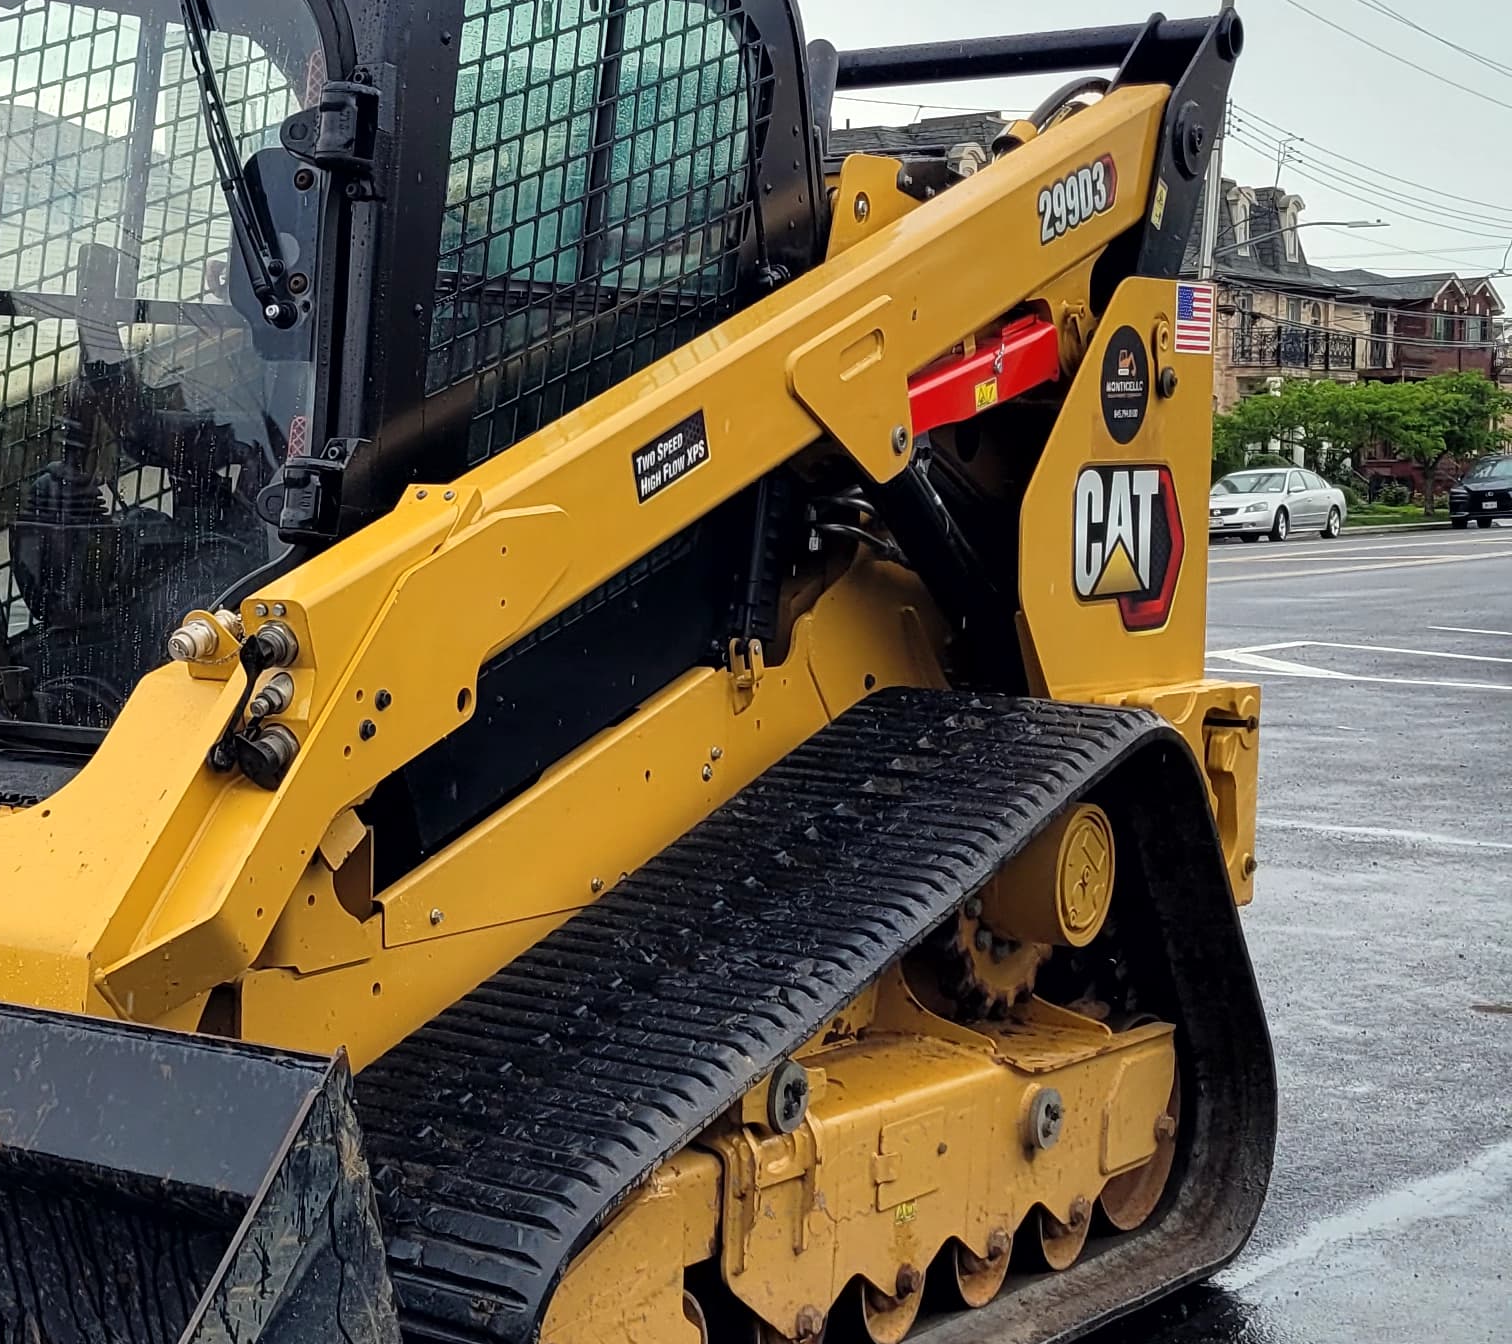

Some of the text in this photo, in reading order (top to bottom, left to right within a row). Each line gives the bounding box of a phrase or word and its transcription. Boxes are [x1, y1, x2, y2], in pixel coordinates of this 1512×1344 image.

[1039, 161, 1107, 243] 299D3
[687, 439, 705, 467] XPS
[1075, 469, 1160, 596] CAT
